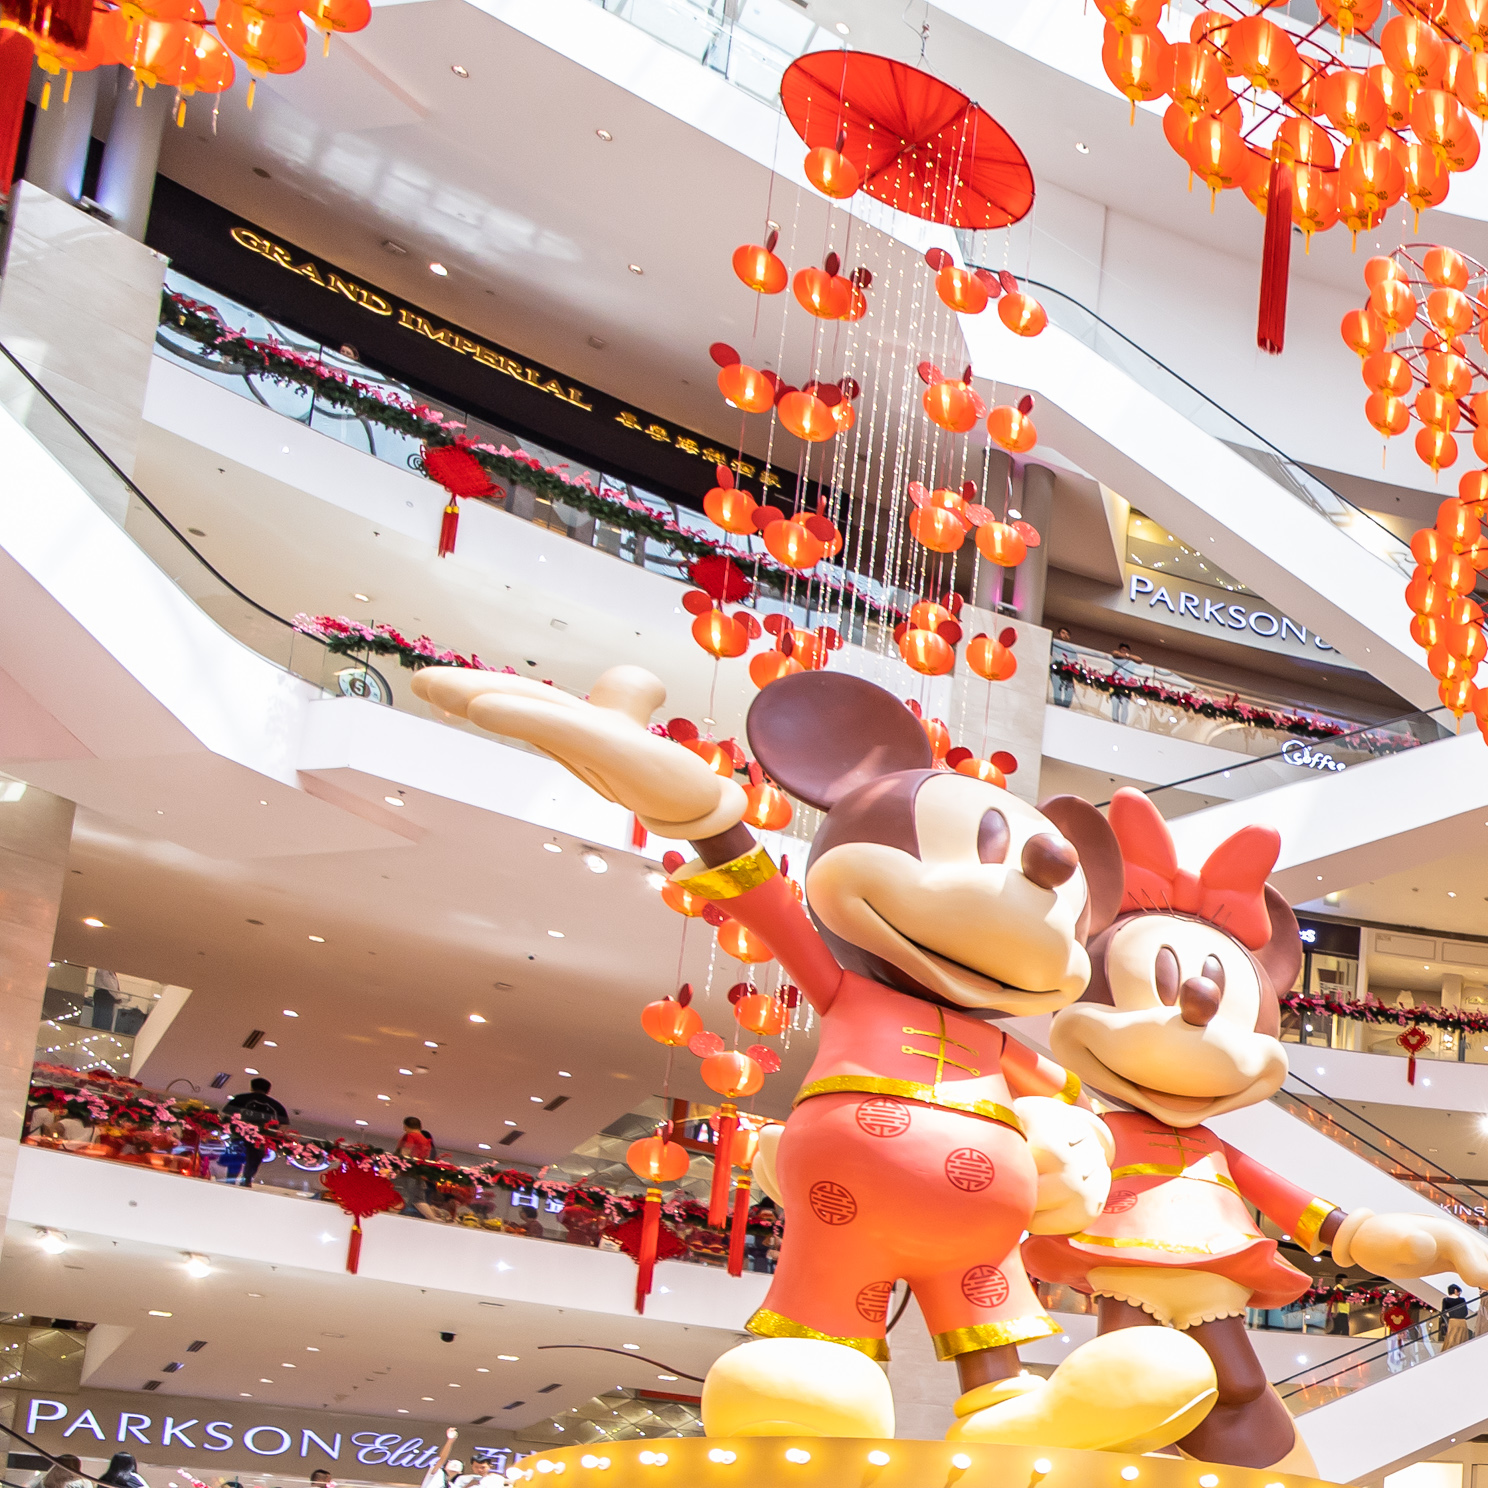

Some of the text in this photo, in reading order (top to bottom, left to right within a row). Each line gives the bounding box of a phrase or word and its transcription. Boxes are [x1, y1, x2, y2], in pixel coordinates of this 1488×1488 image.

[230, 227, 593, 412] GRAND IMPERIAL
[1129, 574, 1307, 644] PARKSON
[26, 1398, 342, 1459] PARKSON
